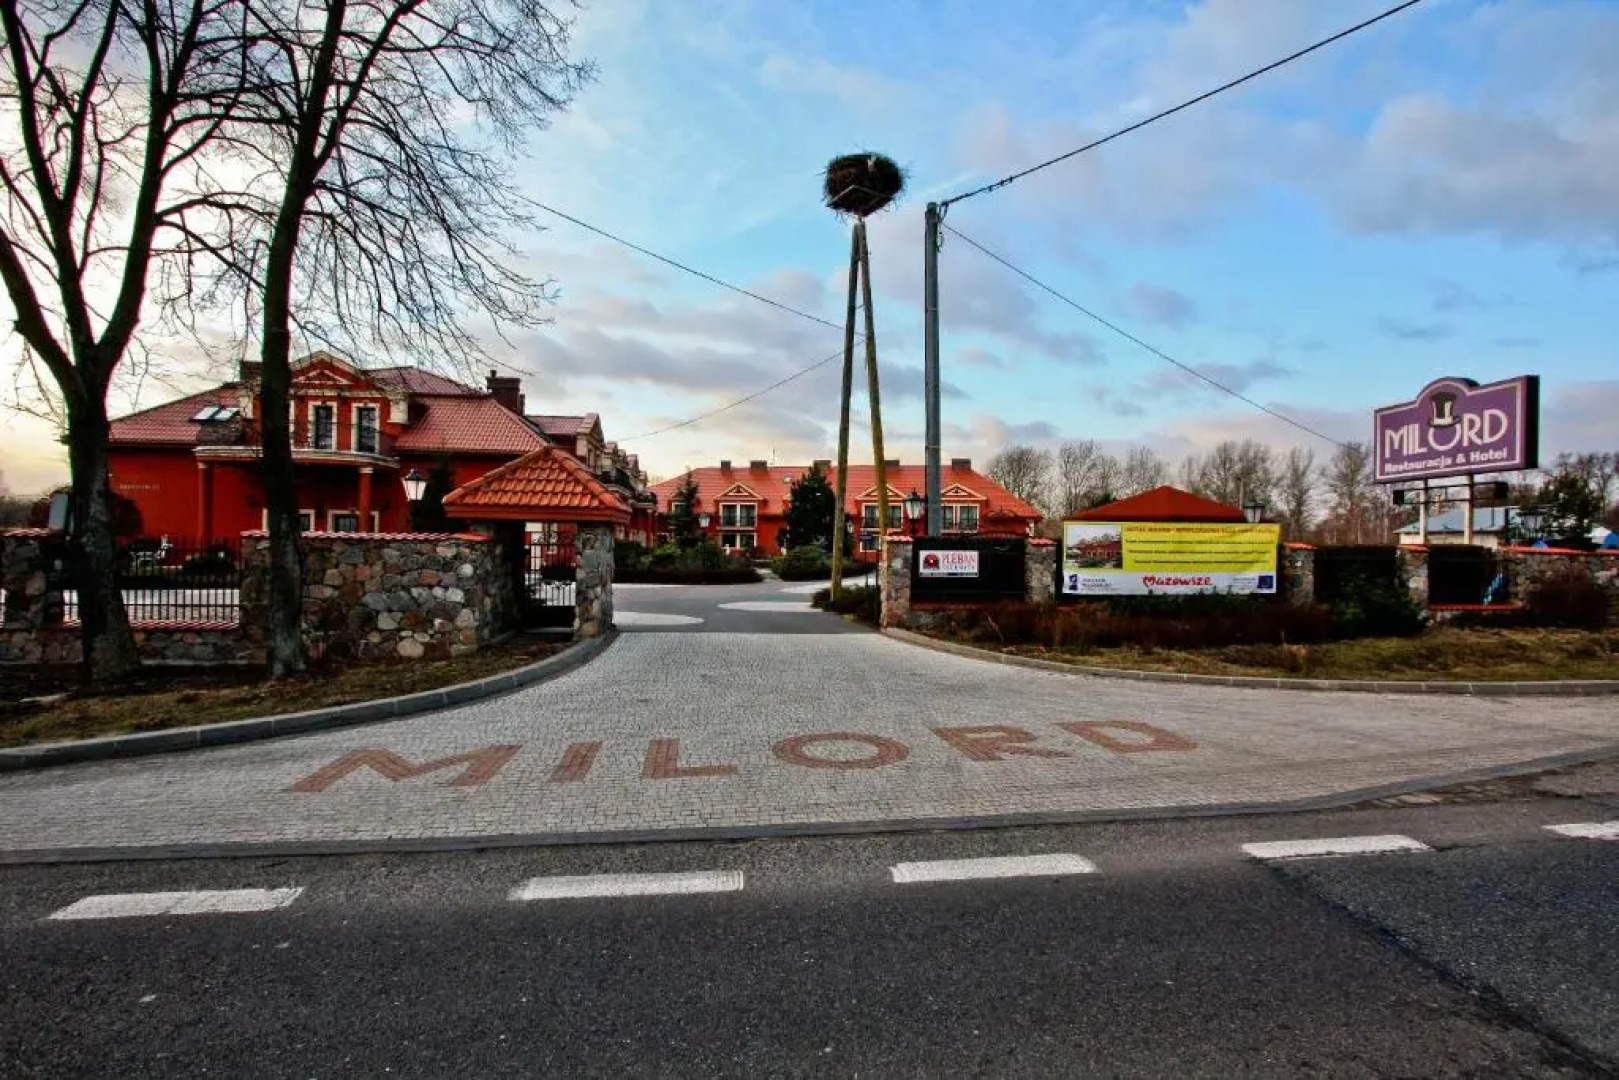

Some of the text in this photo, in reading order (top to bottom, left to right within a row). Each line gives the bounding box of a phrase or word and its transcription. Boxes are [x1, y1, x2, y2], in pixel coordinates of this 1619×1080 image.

[1384, 409, 1508, 458] MILORD
[1384, 447, 1508, 473] Restauracja & Hotel
[290, 719, 1201, 793] MILORD
